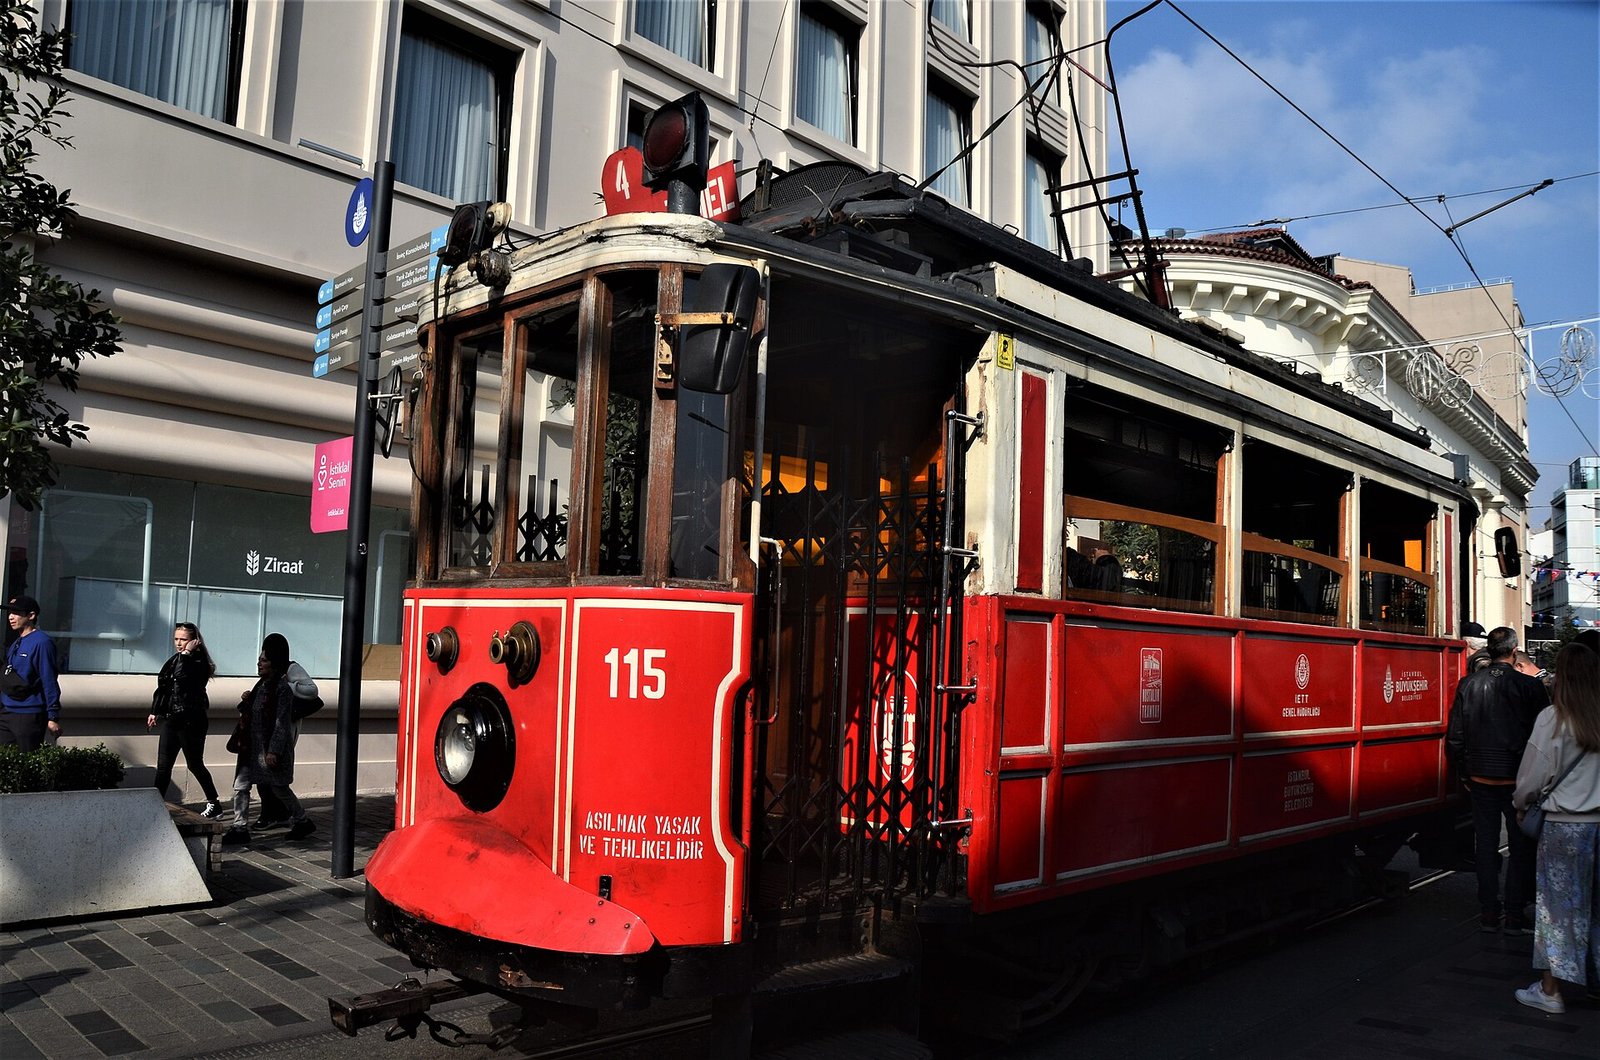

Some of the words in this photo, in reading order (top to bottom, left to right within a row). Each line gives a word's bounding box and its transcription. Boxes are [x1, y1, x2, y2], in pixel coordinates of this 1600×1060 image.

[616, 160, 630, 200] 4
[329, 460, 350, 476] İstiklal
[328, 476, 347, 489] Senin
[263, 556, 304, 574] Ziraat
[604, 647, 667, 700] 115
[1395, 676, 1429, 695] BÜYÜKŞEHİR
[1282, 707, 1297, 718] GENEL
[585, 810, 647, 834] ASILMAK
[654, 815, 701, 835] YASAK
[579, 834, 596, 855] VE
[602, 837, 704, 860] TEHLİKELİDİR
